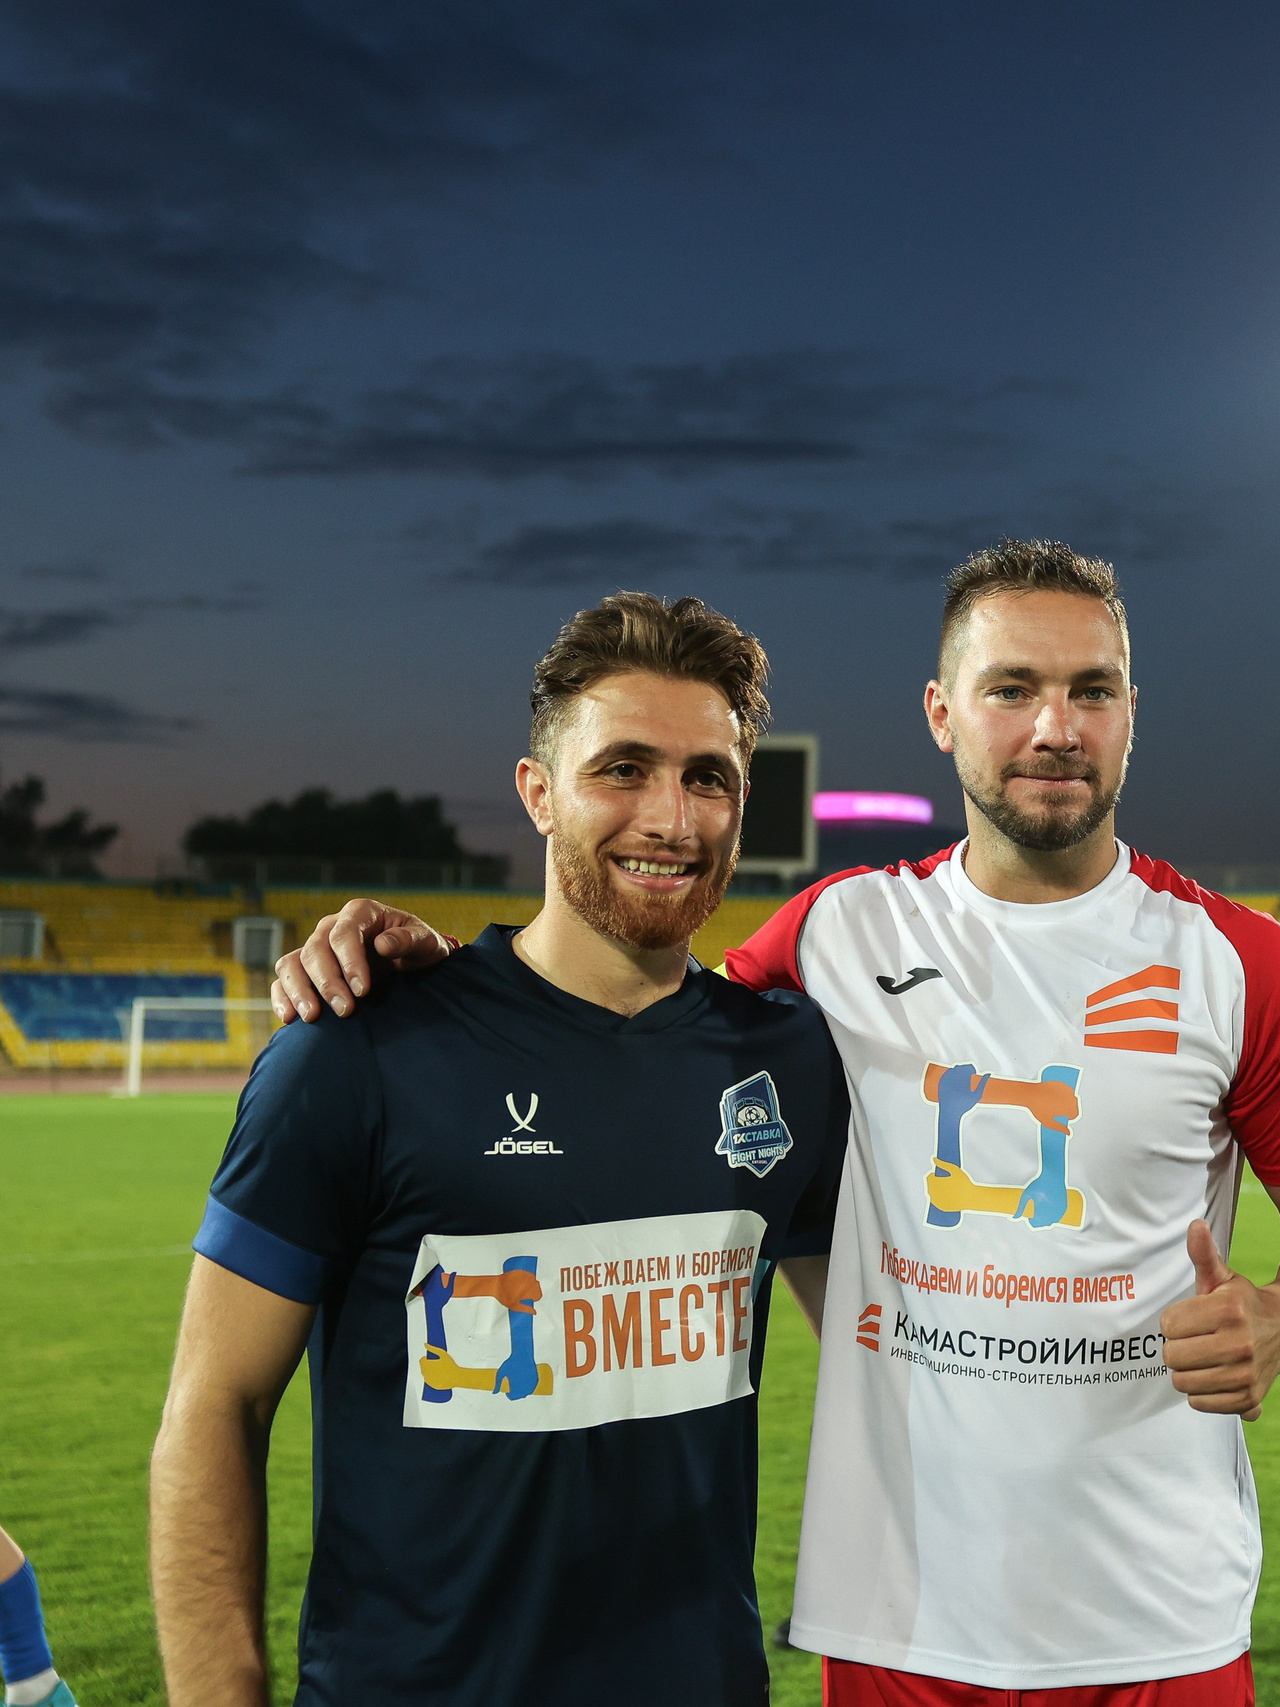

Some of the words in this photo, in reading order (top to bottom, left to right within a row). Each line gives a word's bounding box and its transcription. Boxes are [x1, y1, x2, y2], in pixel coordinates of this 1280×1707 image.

[484, 1137, 564, 1155] JÖGEL
[731, 1149, 757, 1164] FIGHT
[757, 1145, 785, 1160] NIGHTS
[560, 1255, 671, 1293] ПОБЕЖДАЕМ
[676, 1253, 686, 1279] И
[692, 1246, 755, 1277] БОРЕМСЯ
[881, 1241, 962, 1295] Побеждаем
[966, 1270, 978, 1297] и
[983, 1264, 1068, 1308] боремся
[1073, 1272, 1136, 1303] вместе
[563, 1276, 752, 1379] ВМЕСТЕ
[890, 1346, 1101, 1385] ИНВЕСТИЦИОННО-СТРОИТЕЛЬНАЯ
[1104, 1364, 1168, 1383] КОМПАНИЯ
